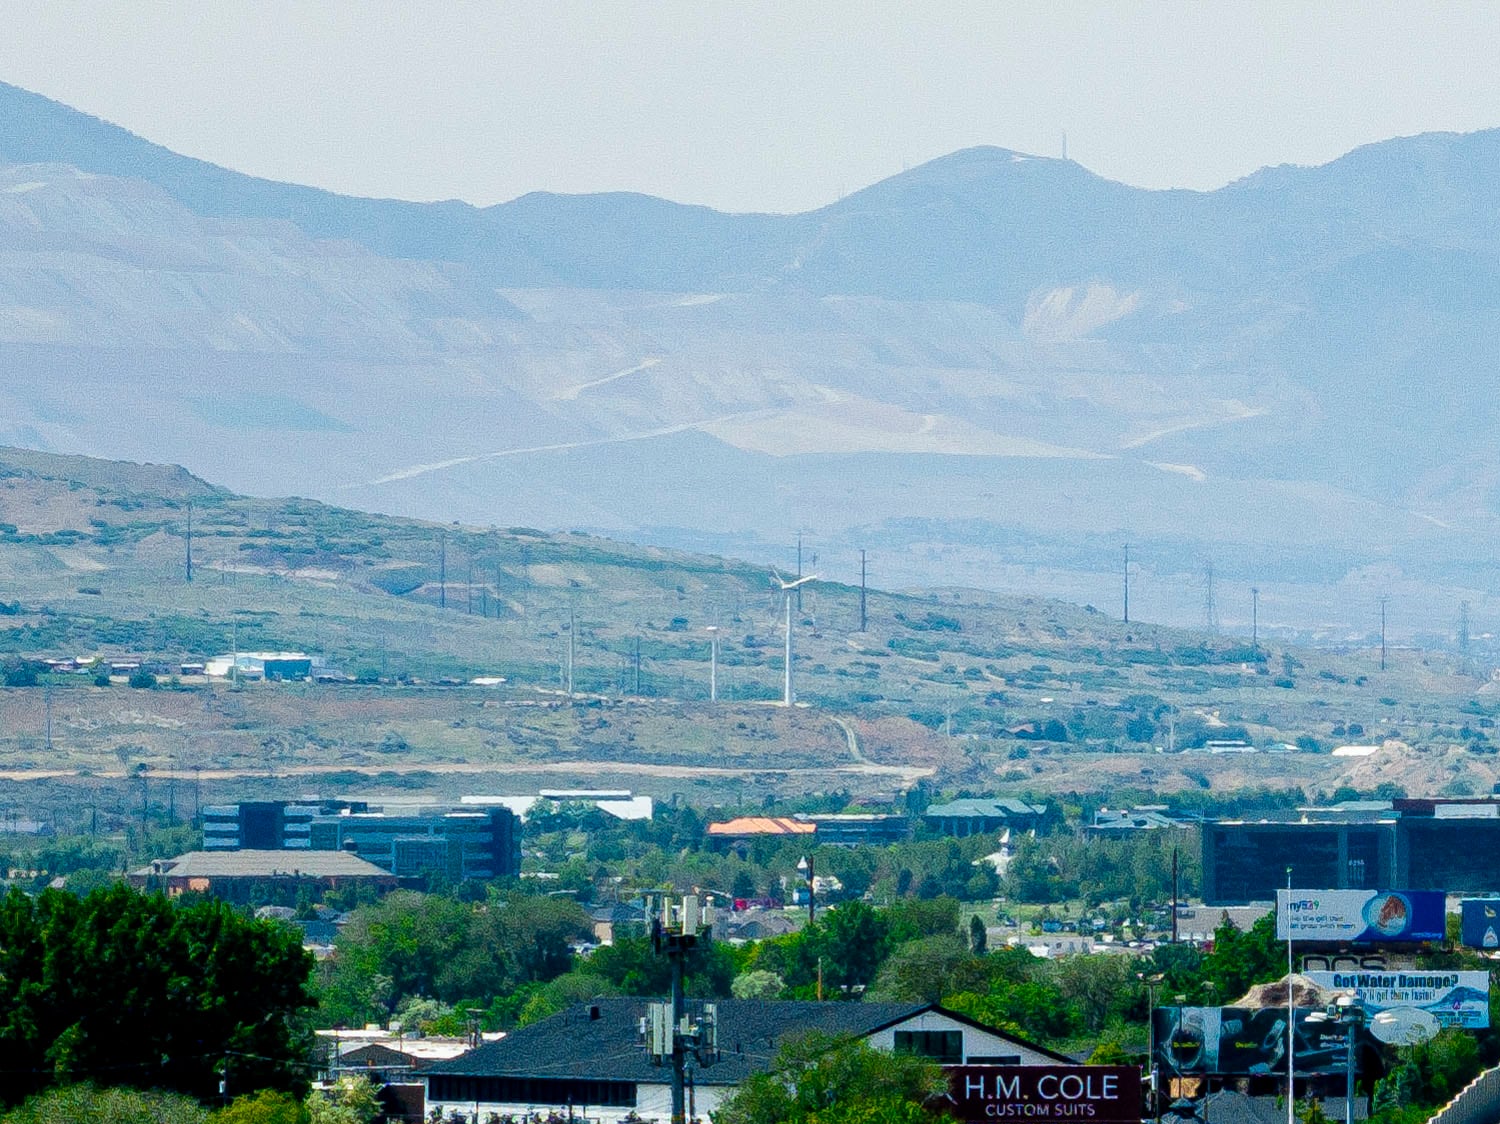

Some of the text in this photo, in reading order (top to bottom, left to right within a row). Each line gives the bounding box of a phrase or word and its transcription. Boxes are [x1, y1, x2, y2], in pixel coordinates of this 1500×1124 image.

[1333, 974, 1356, 988] Got
[1357, 974, 1397, 988] Water
[965, 1074, 1119, 1100] H.M. COLE
[985, 1103, 1096, 1117] CUSTOM SUITS
